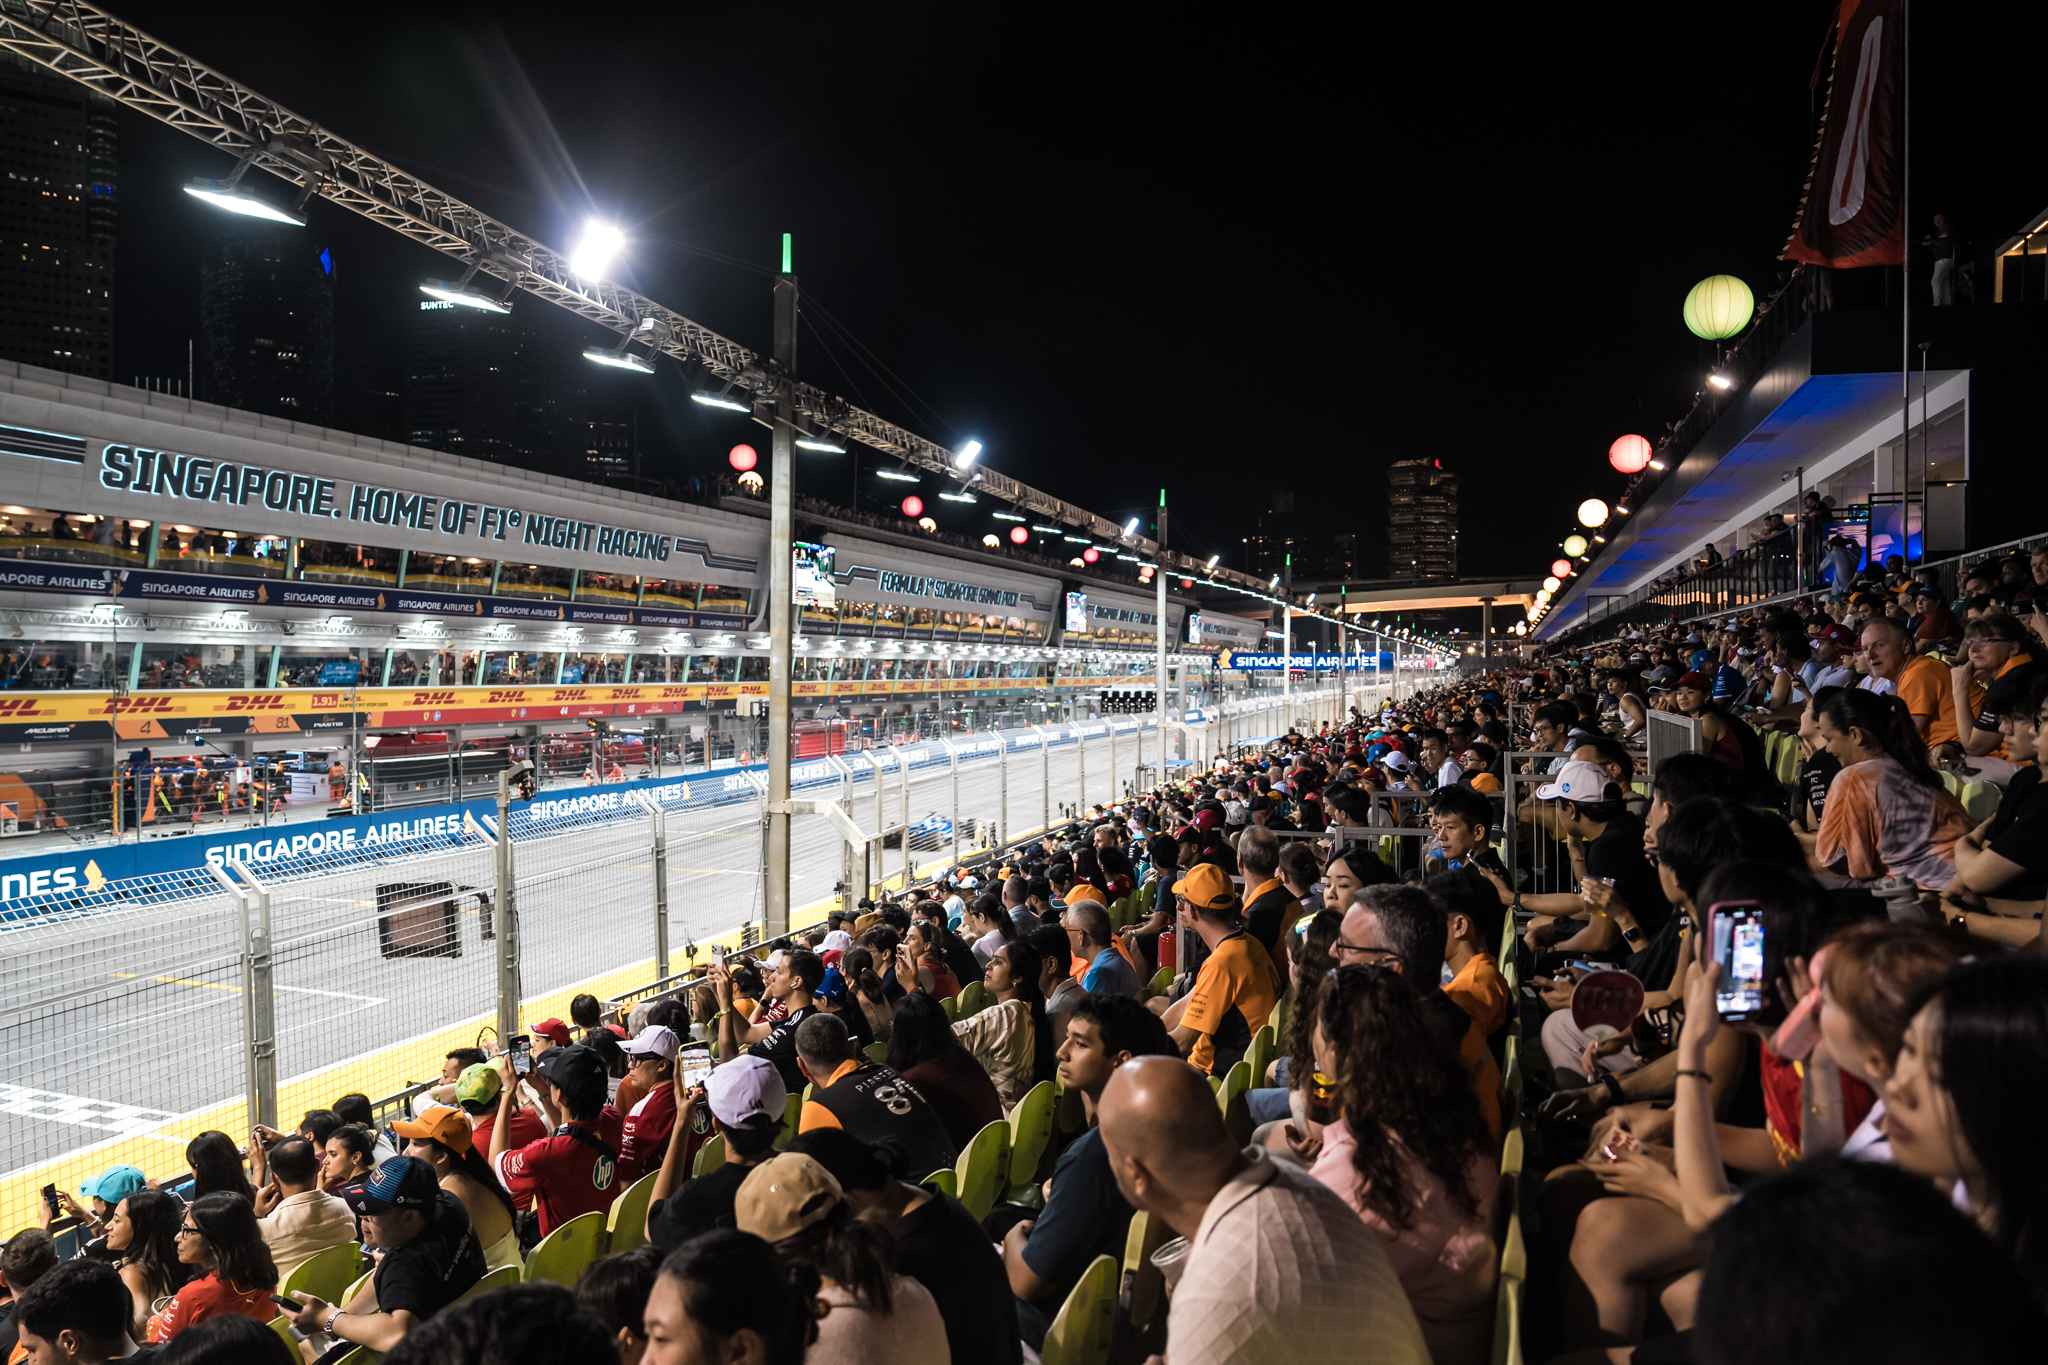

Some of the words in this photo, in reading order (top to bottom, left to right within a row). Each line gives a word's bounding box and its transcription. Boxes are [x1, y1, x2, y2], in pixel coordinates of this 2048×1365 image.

[421, 301, 454, 310] SUNTEC
[99, 443, 342, 519] SINGAPORE.
[349, 484, 438, 531] HOME
[439, 500, 478, 535] OF
[522, 513, 596, 552] NIGHT
[595, 525, 671, 562] RACING
[48, 577, 106, 590] AIRLINES
[878, 569, 923, 596] FORMULA
[142, 582, 207, 596] SINGAPORE
[209, 587, 255, 599] AIRLINES
[283, 592, 336, 604] SINGAPORE
[338, 596, 375, 606] AIRLINES
[398, 600, 441, 610] SINGAPORE
[443, 604, 475, 612] AIRLINES
[493, 606, 529, 615] SINGAPORE
[530, 609, 558, 617] AIRLINES
[573, 611, 604, 620] SINGAPORE
[1236, 656, 1313, 667] SINGAPORE
[1316, 656, 1378, 667] AIRLINES
[553, 690, 587, 701] DHL
[611, 688, 641, 699] DHL
[662, 687, 688, 697] DHL
[706, 686, 729, 696] DHL
[741, 686, 762, 694] DHL
[225, 695, 285, 710] DHL
[412, 692, 456, 705] DHL
[487, 691, 525, 703] DHL
[102, 697, 174, 714] DHL
[560, 706, 568, 715] 44
[140, 720, 151, 734] 4
[276, 717, 290, 728] 81
[529, 792, 618, 821] SINGAPORE
[205, 828, 356, 868] SINGAPORE
[364, 814, 459, 847] AIRLINES
[597, 1157, 612, 1189] hp
